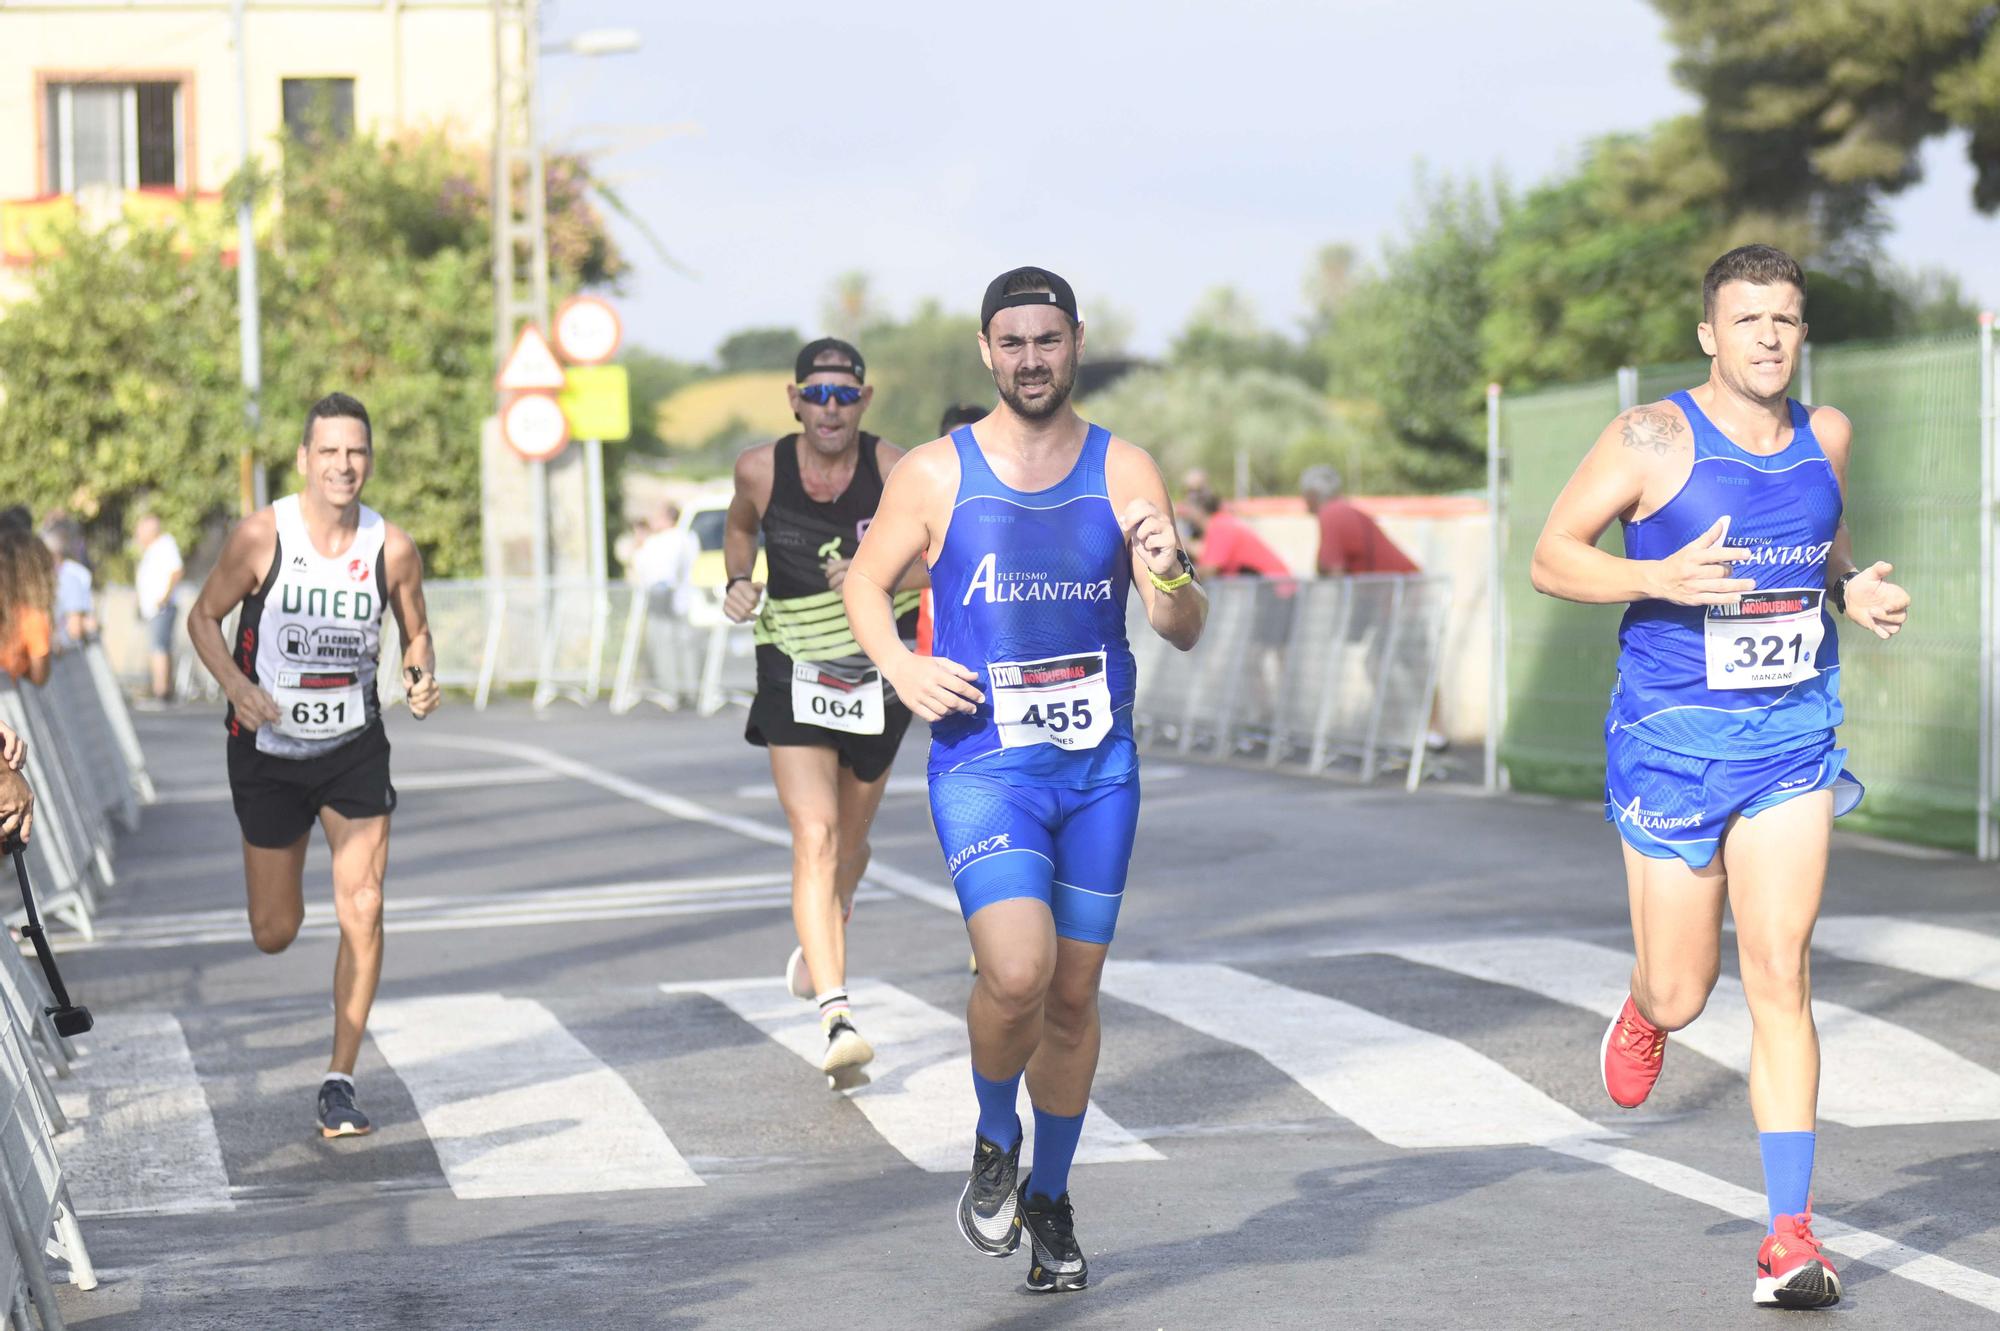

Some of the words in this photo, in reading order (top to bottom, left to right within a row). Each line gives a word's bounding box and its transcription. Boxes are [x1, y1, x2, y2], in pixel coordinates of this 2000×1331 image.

[281, 584, 372, 621] UNED
[1733, 632, 1803, 668] 321
[1023, 665, 1086, 684] NONDUERMAS
[1751, 672, 1793, 681] MANZANO
[291, 702, 345, 725] 631
[811, 696, 865, 720] 064
[1020, 698, 1093, 733] 455
